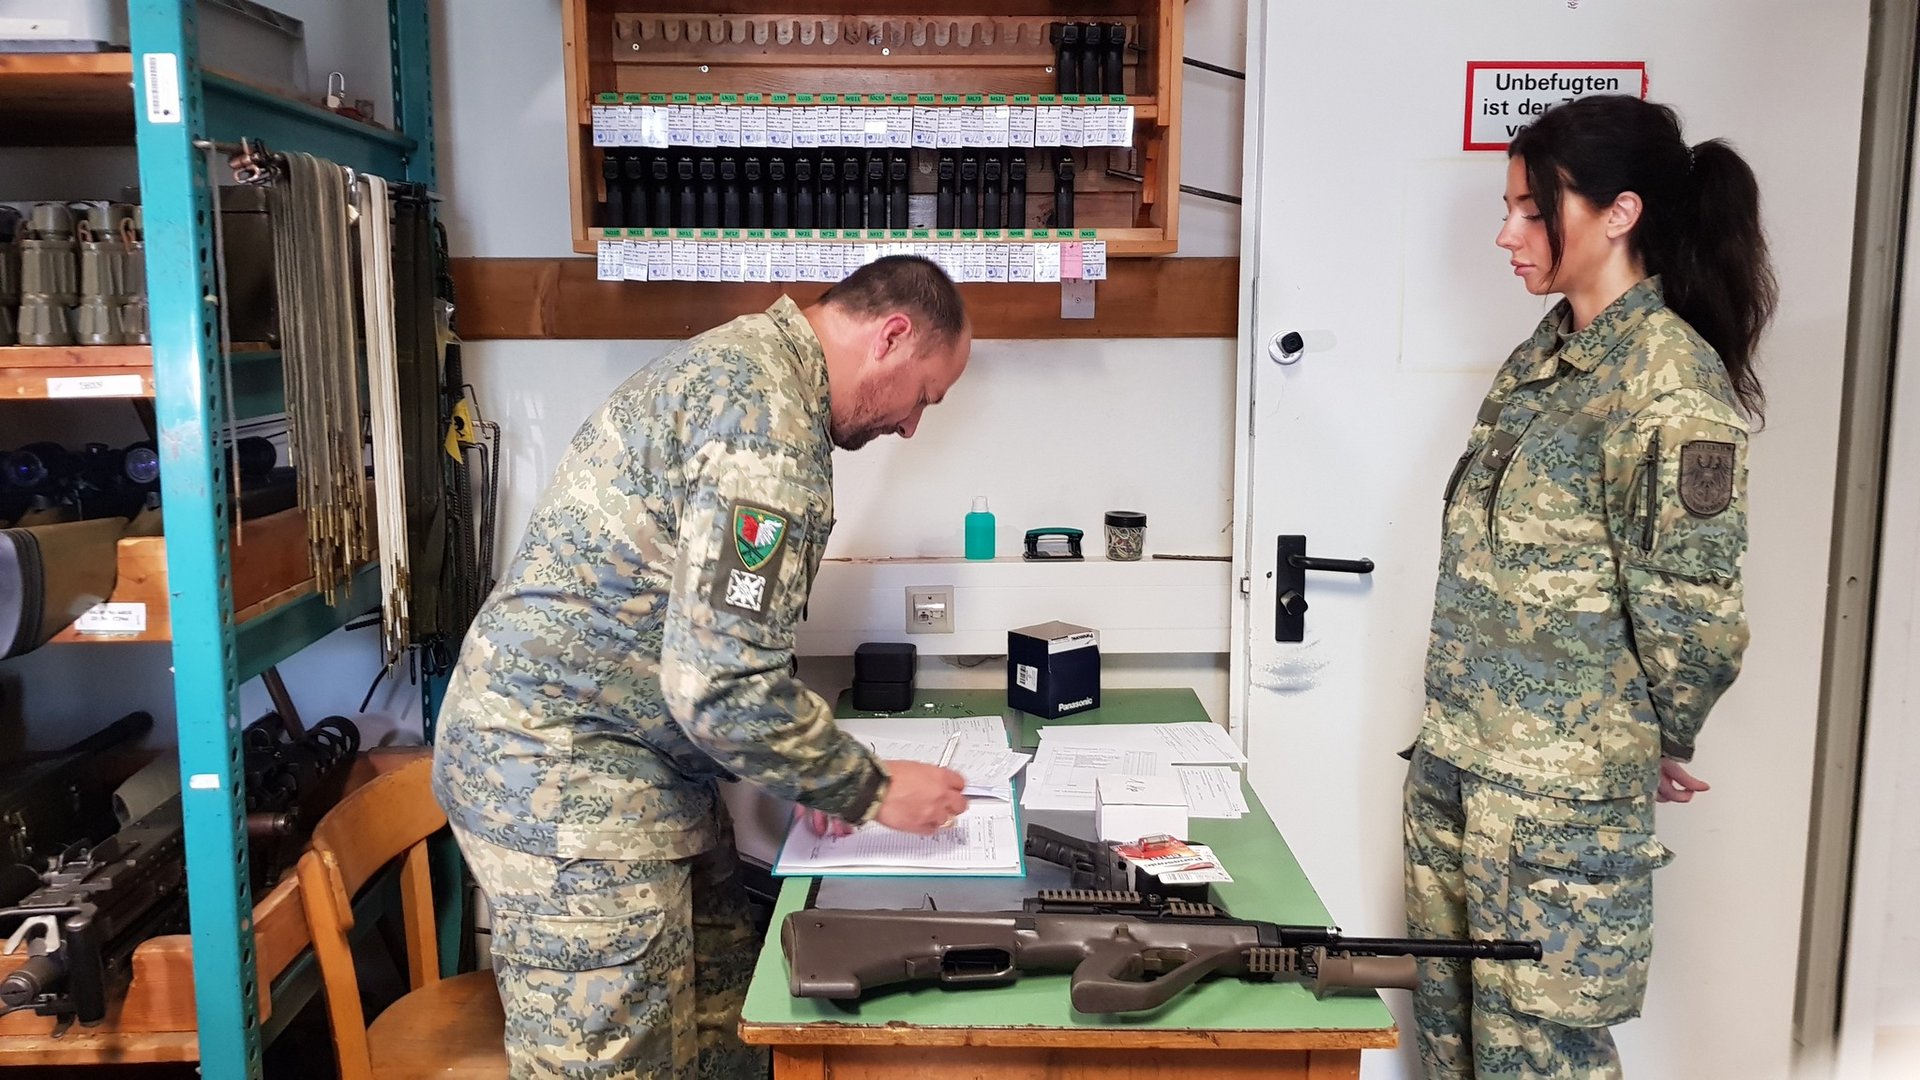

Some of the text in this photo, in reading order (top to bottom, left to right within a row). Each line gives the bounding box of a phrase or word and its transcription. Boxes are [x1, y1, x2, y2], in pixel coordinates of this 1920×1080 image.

[1496, 73, 1619, 94] Unbefugten
[1483, 98, 1552, 115] ist der
[1058, 697, 1093, 712] Panasonic
